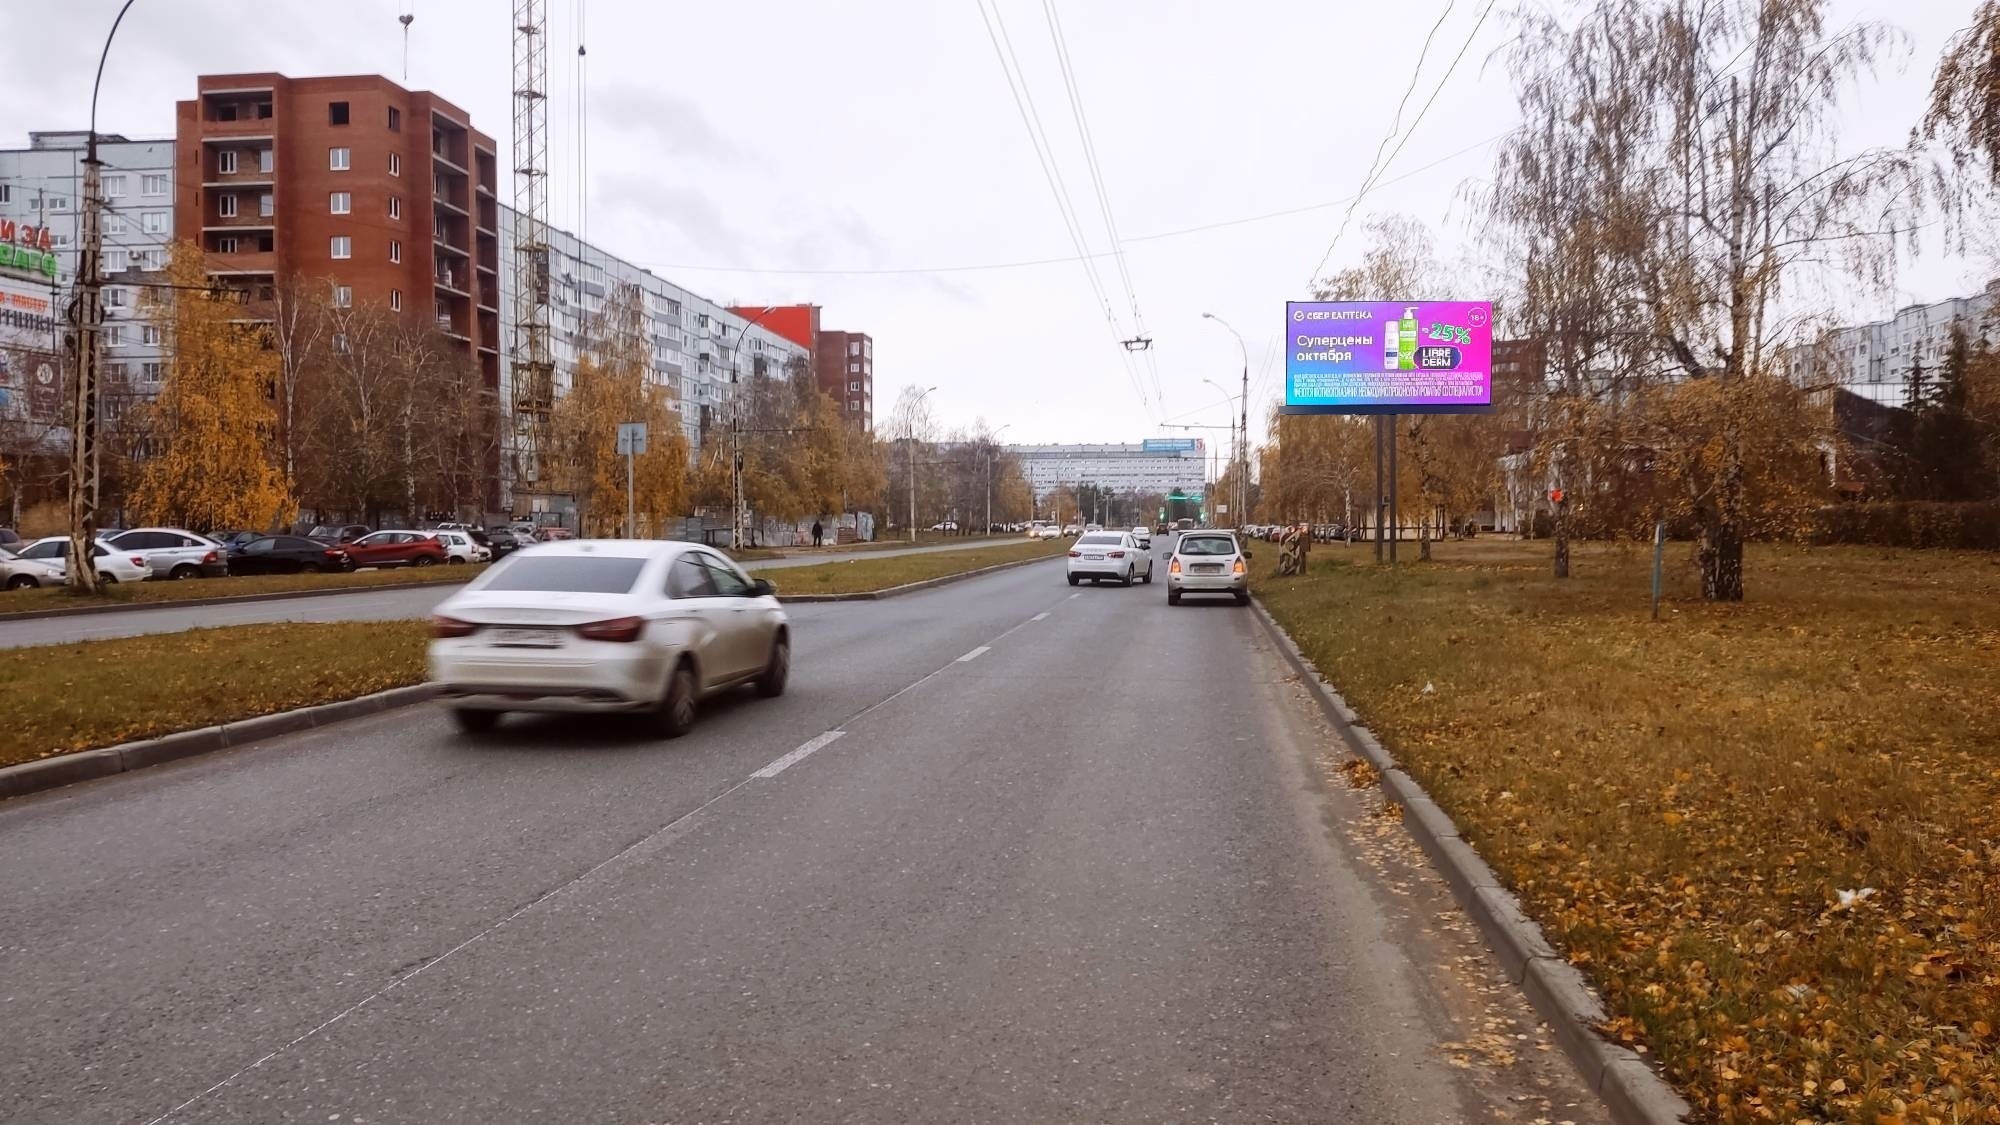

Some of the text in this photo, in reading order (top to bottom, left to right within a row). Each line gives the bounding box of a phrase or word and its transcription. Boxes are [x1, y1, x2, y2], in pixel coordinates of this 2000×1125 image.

[1422, 323, 1471, 344] -25%
[1297, 335, 1373, 347] Суперцены
[1297, 348, 1352, 363] октября
[1422, 348, 1451, 358] LIBRE
[1422, 358, 1451, 367] DERM
